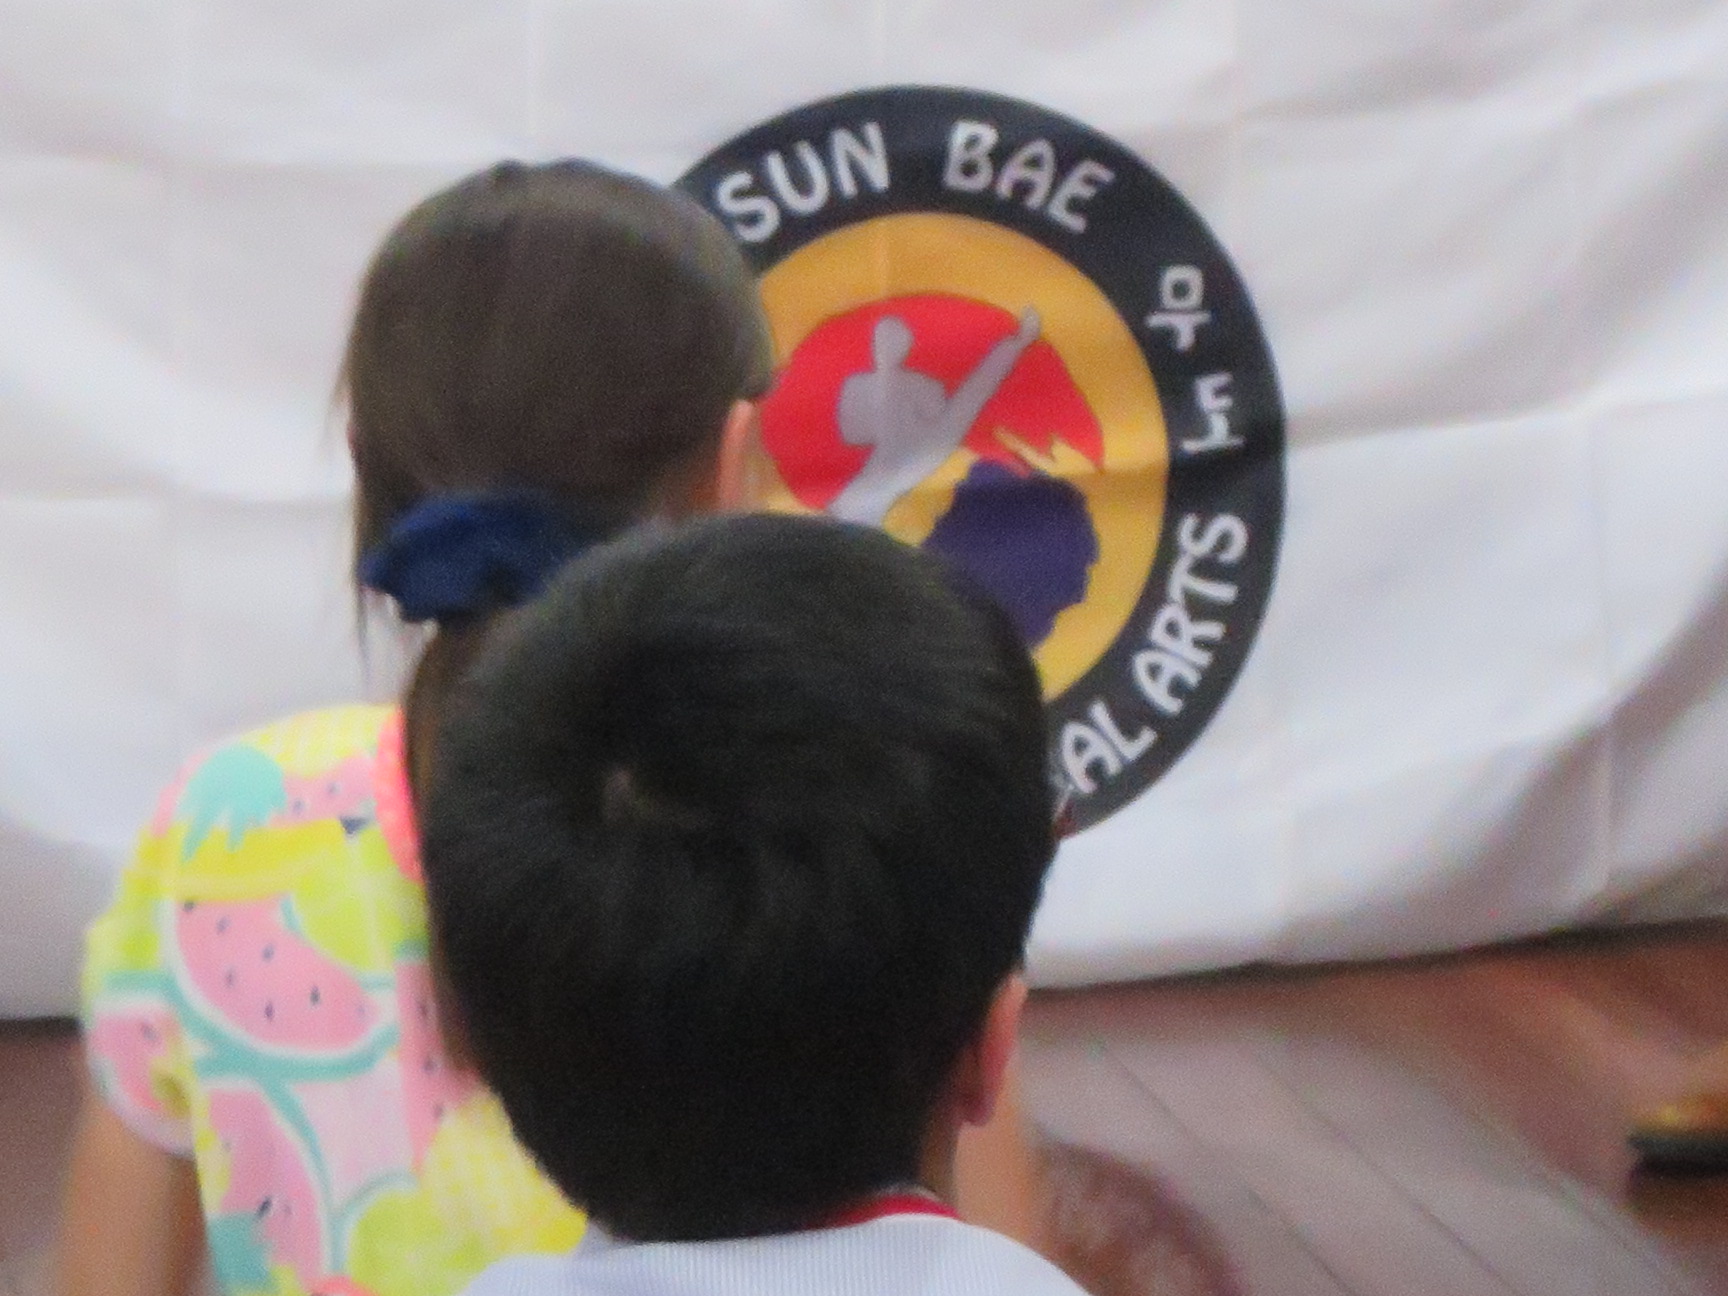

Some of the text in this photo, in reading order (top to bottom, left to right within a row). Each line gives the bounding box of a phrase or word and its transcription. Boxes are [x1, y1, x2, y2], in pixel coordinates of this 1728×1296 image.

[717, 119, 1116, 243] SUN BAE
[1056, 512, 1249, 793] AL ARTS
